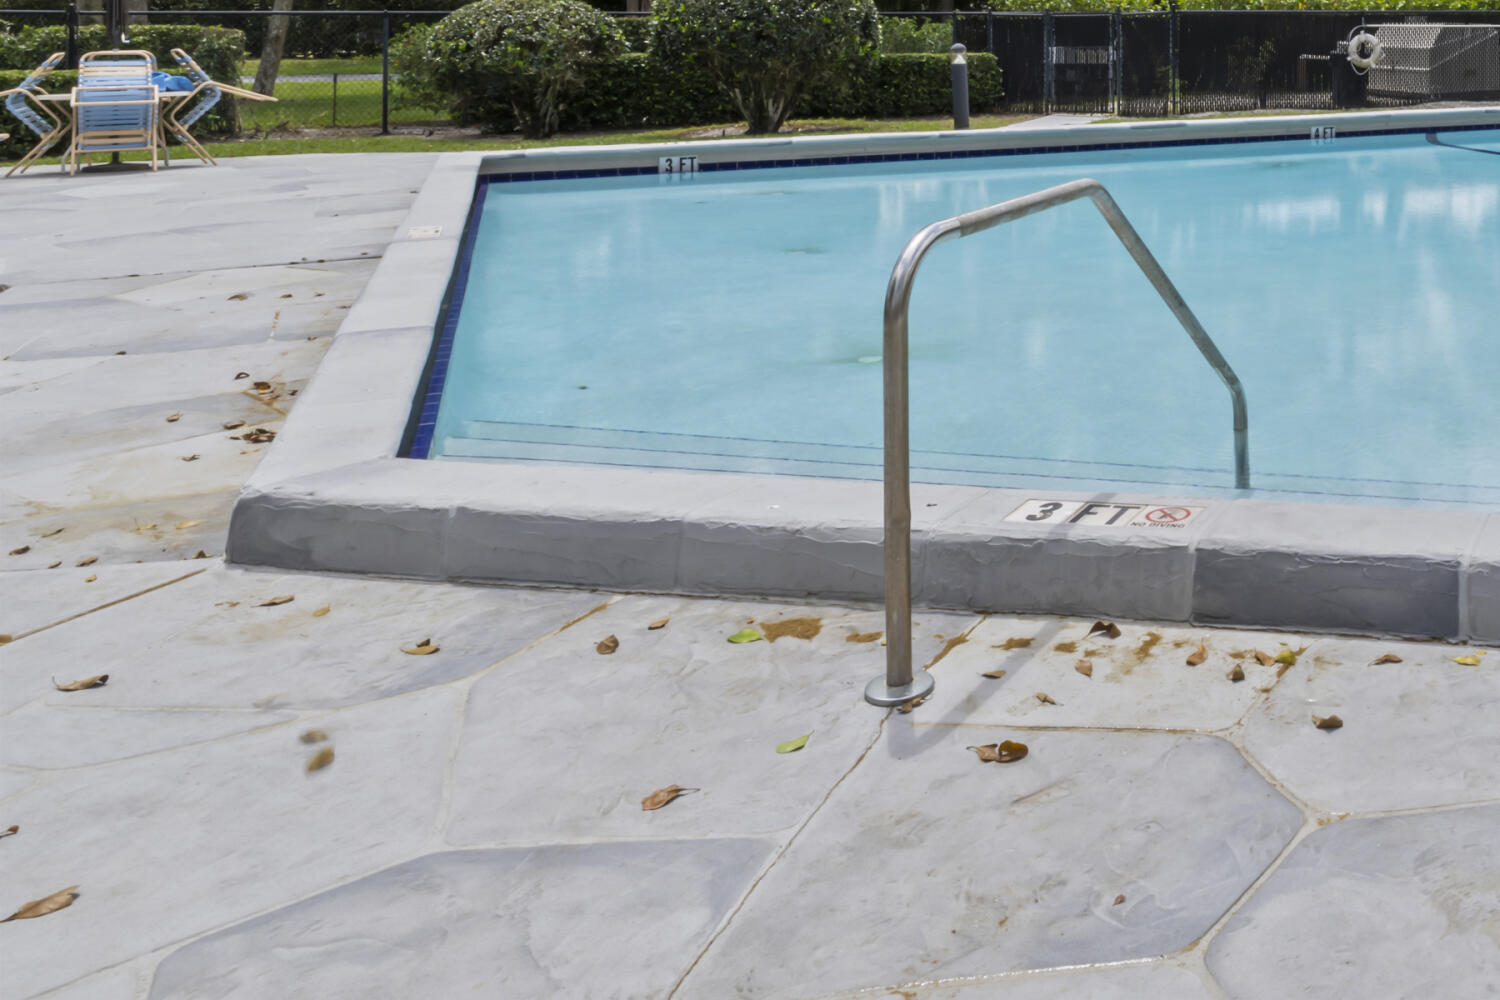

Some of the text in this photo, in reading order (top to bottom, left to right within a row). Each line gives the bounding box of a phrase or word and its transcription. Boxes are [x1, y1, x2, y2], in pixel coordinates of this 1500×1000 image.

[1323, 127, 1335, 138] FT
[665, 156, 697, 173] 3 FT
[1026, 502, 1141, 525] 3 FT
